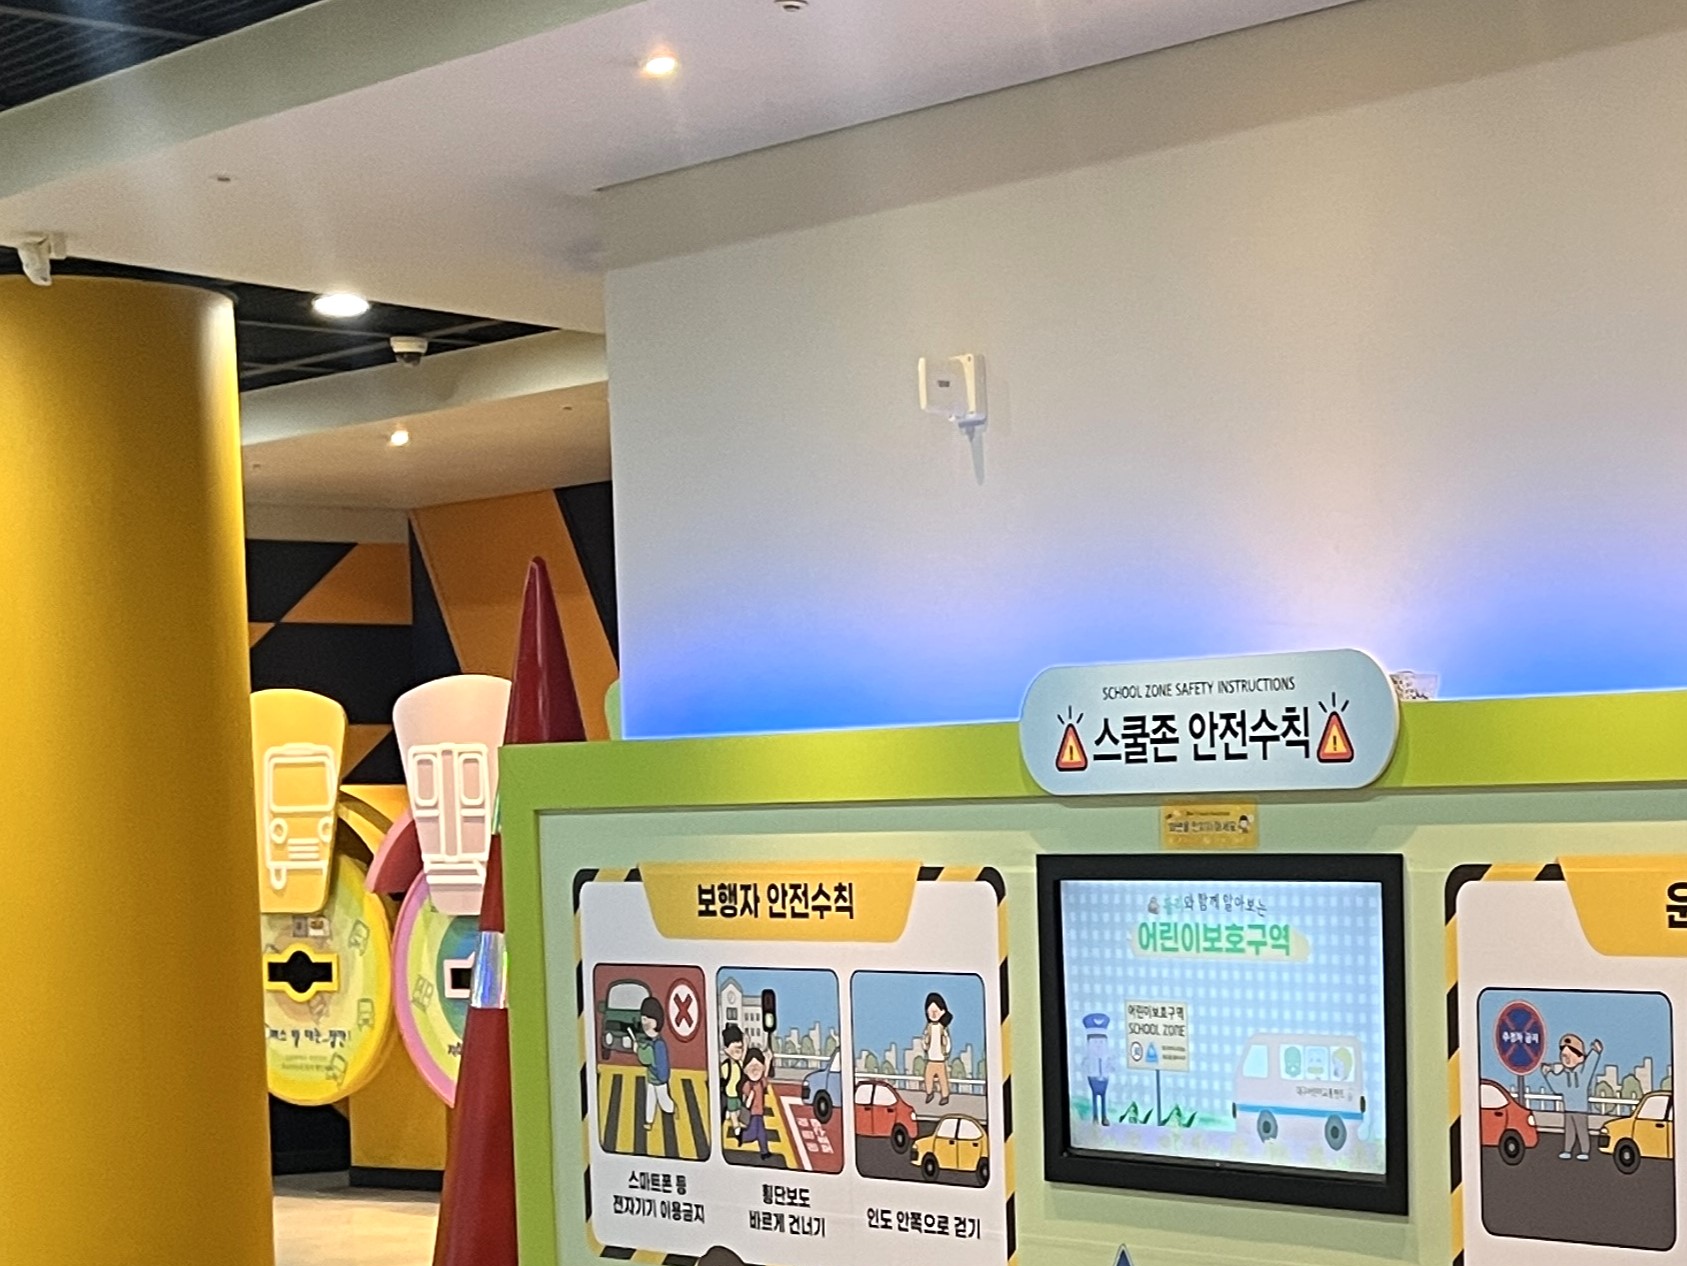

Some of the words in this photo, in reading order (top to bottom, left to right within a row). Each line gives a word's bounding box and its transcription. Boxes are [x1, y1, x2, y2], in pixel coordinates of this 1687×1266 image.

[1102, 685, 1143, 701] SCHOOL
[1145, 683, 1173, 698] ZONE
[1175, 680, 1214, 697] SAFETY
[1217, 676, 1296, 694] INSTRUCTIONS
[1093, 714, 1180, 764] 스쿨존
[1188, 706, 1310, 762] 안전수칙
[697, 882, 761, 919] 보행자
[766, 881, 855, 920] 안전수칙
[1138, 921, 1291, 957] 어린이보호구역
[628, 1170, 673, 1194] 스마트폰
[675, 1174, 687, 1195] 등
[762, 1183, 811, 1208] 횡단보도
[613, 1194, 657, 1218] 전자기기
[660, 1200, 705, 1224] 이용금지
[749, 1210, 785, 1233] 바르게
[788, 1213, 825, 1238] 건너기
[866, 1207, 893, 1230] 인도
[896, 1210, 950, 1236] 안쪽으로
[954, 1216, 981, 1240] 걷기
